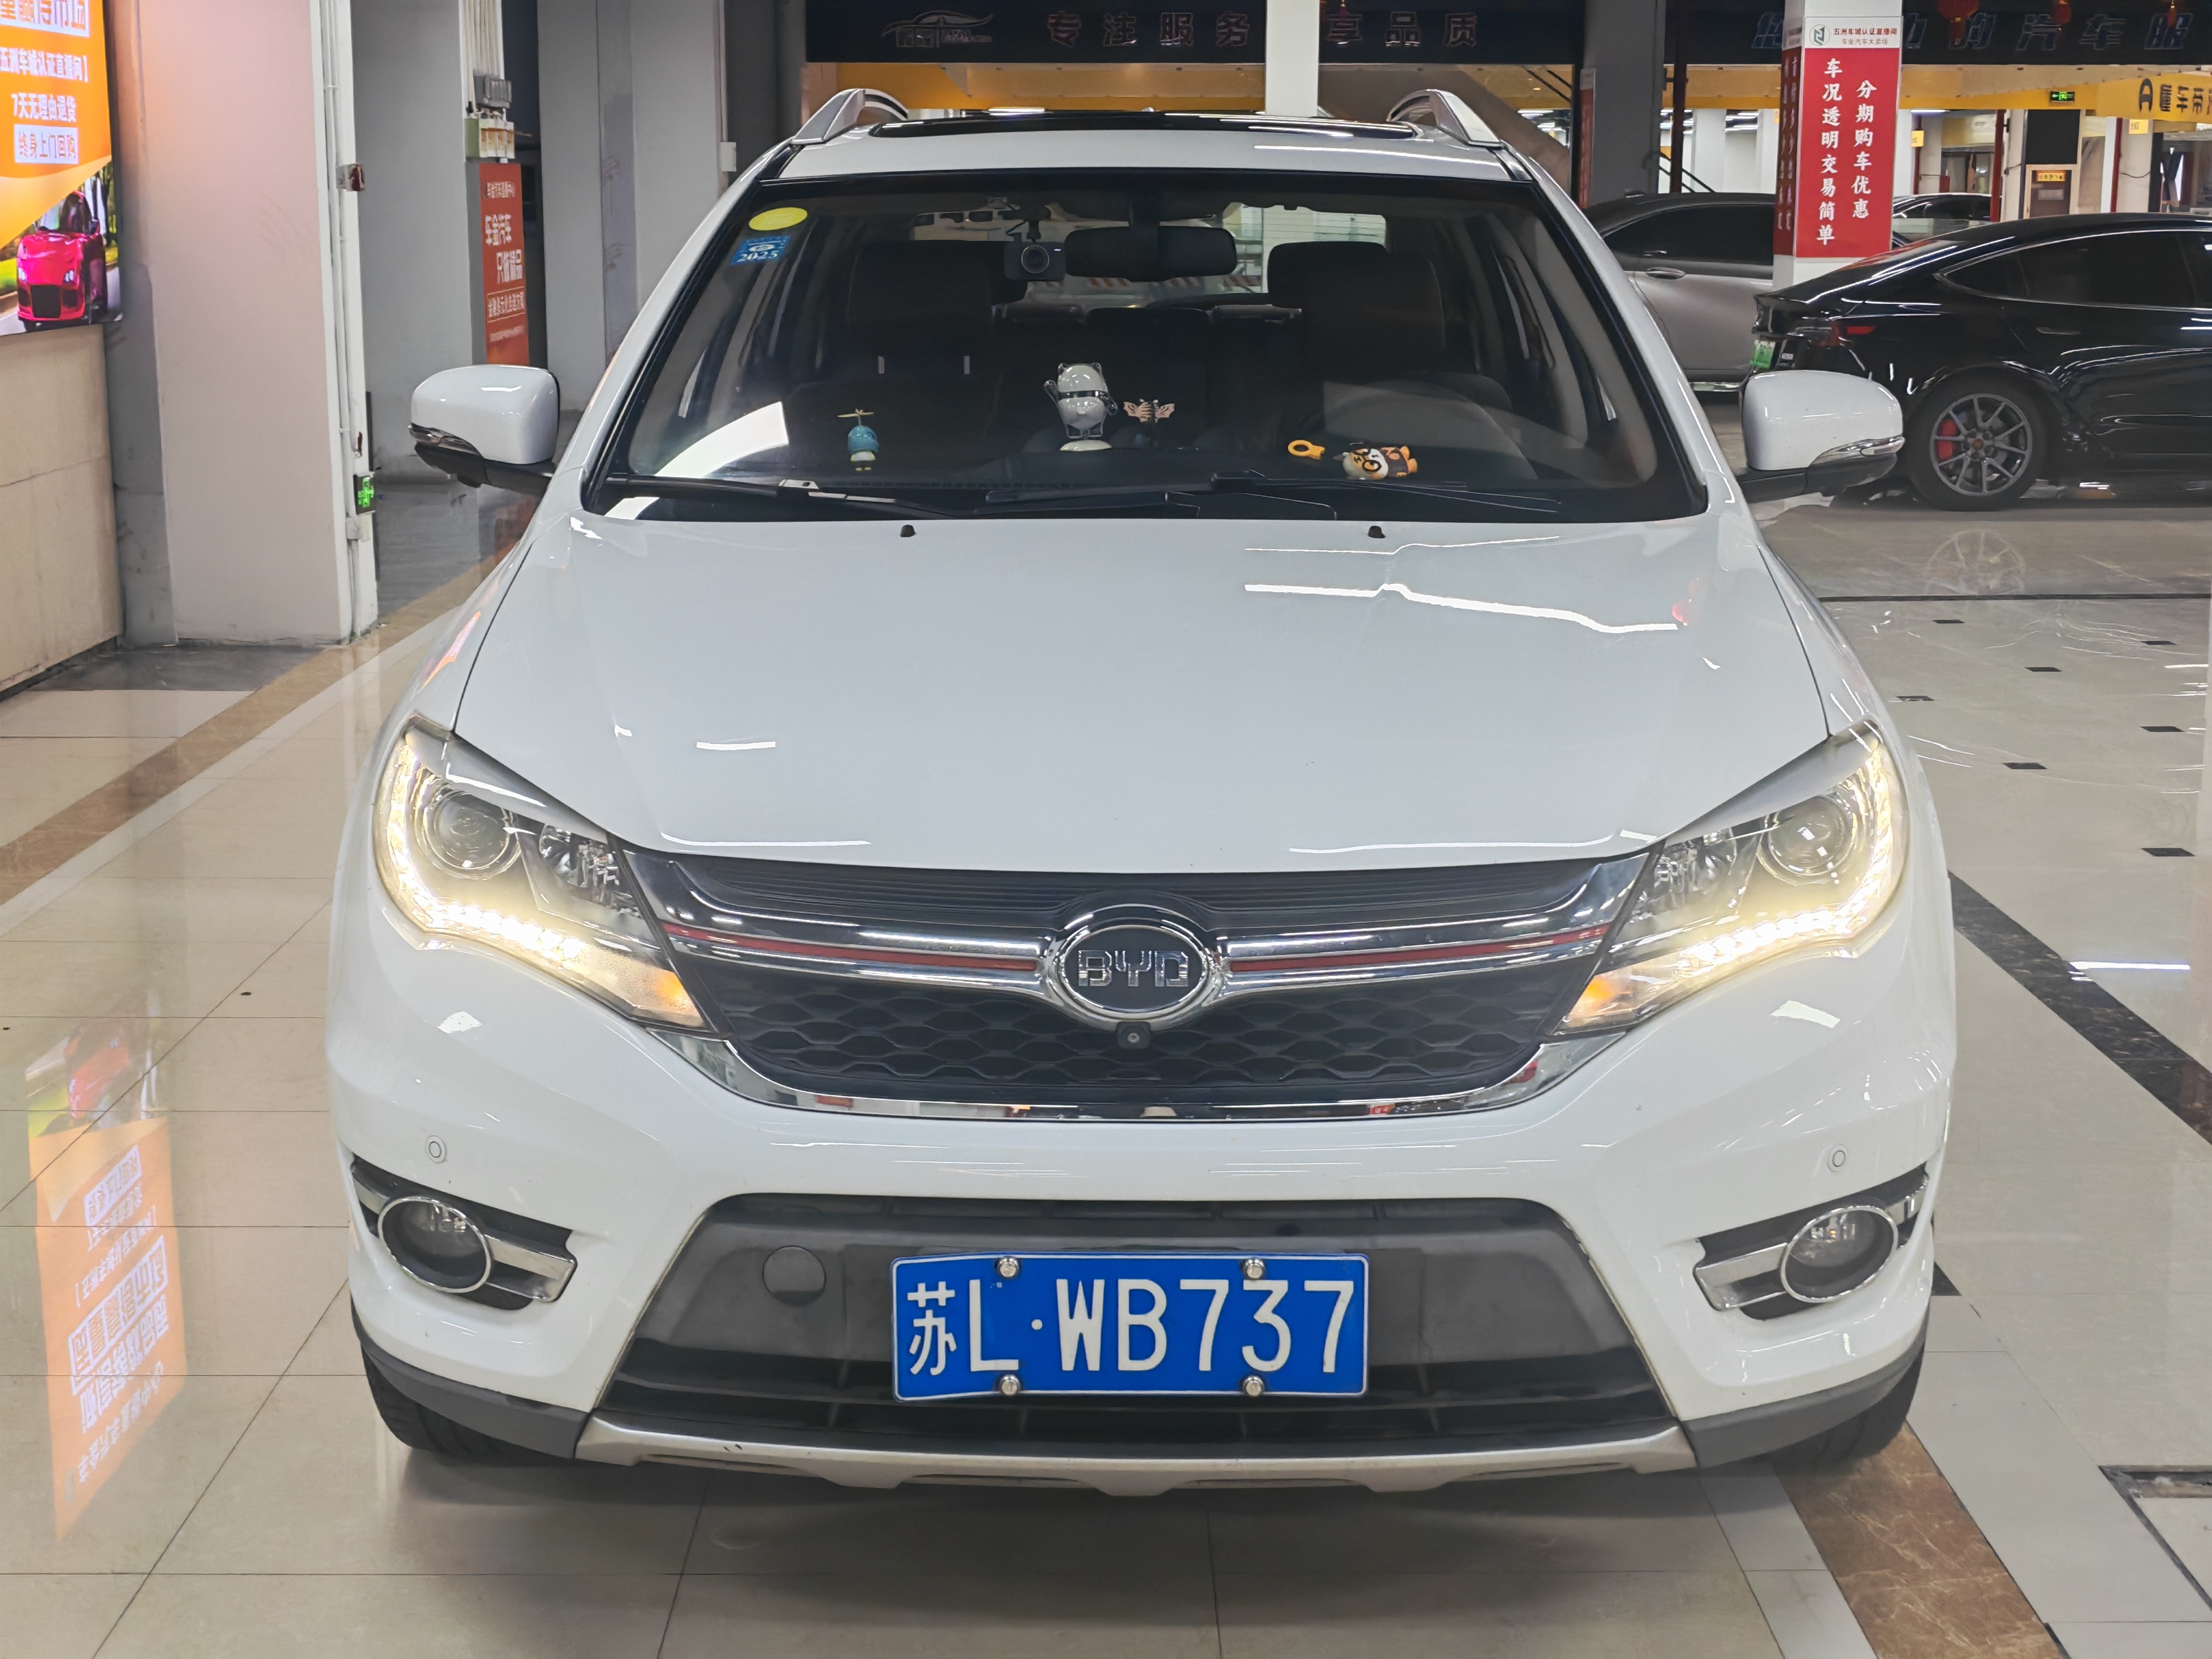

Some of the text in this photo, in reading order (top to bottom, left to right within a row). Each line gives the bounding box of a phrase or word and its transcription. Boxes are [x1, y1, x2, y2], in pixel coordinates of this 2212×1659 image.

[1816, 57, 1843, 246] 车况透明交易简单
[1851, 79, 1877, 219] 分期购车优惠
[736, 249, 779, 263] 2025
[1078, 950, 1189, 987] BYD
[907, 1278, 1355, 1377] 苏L·WB737
